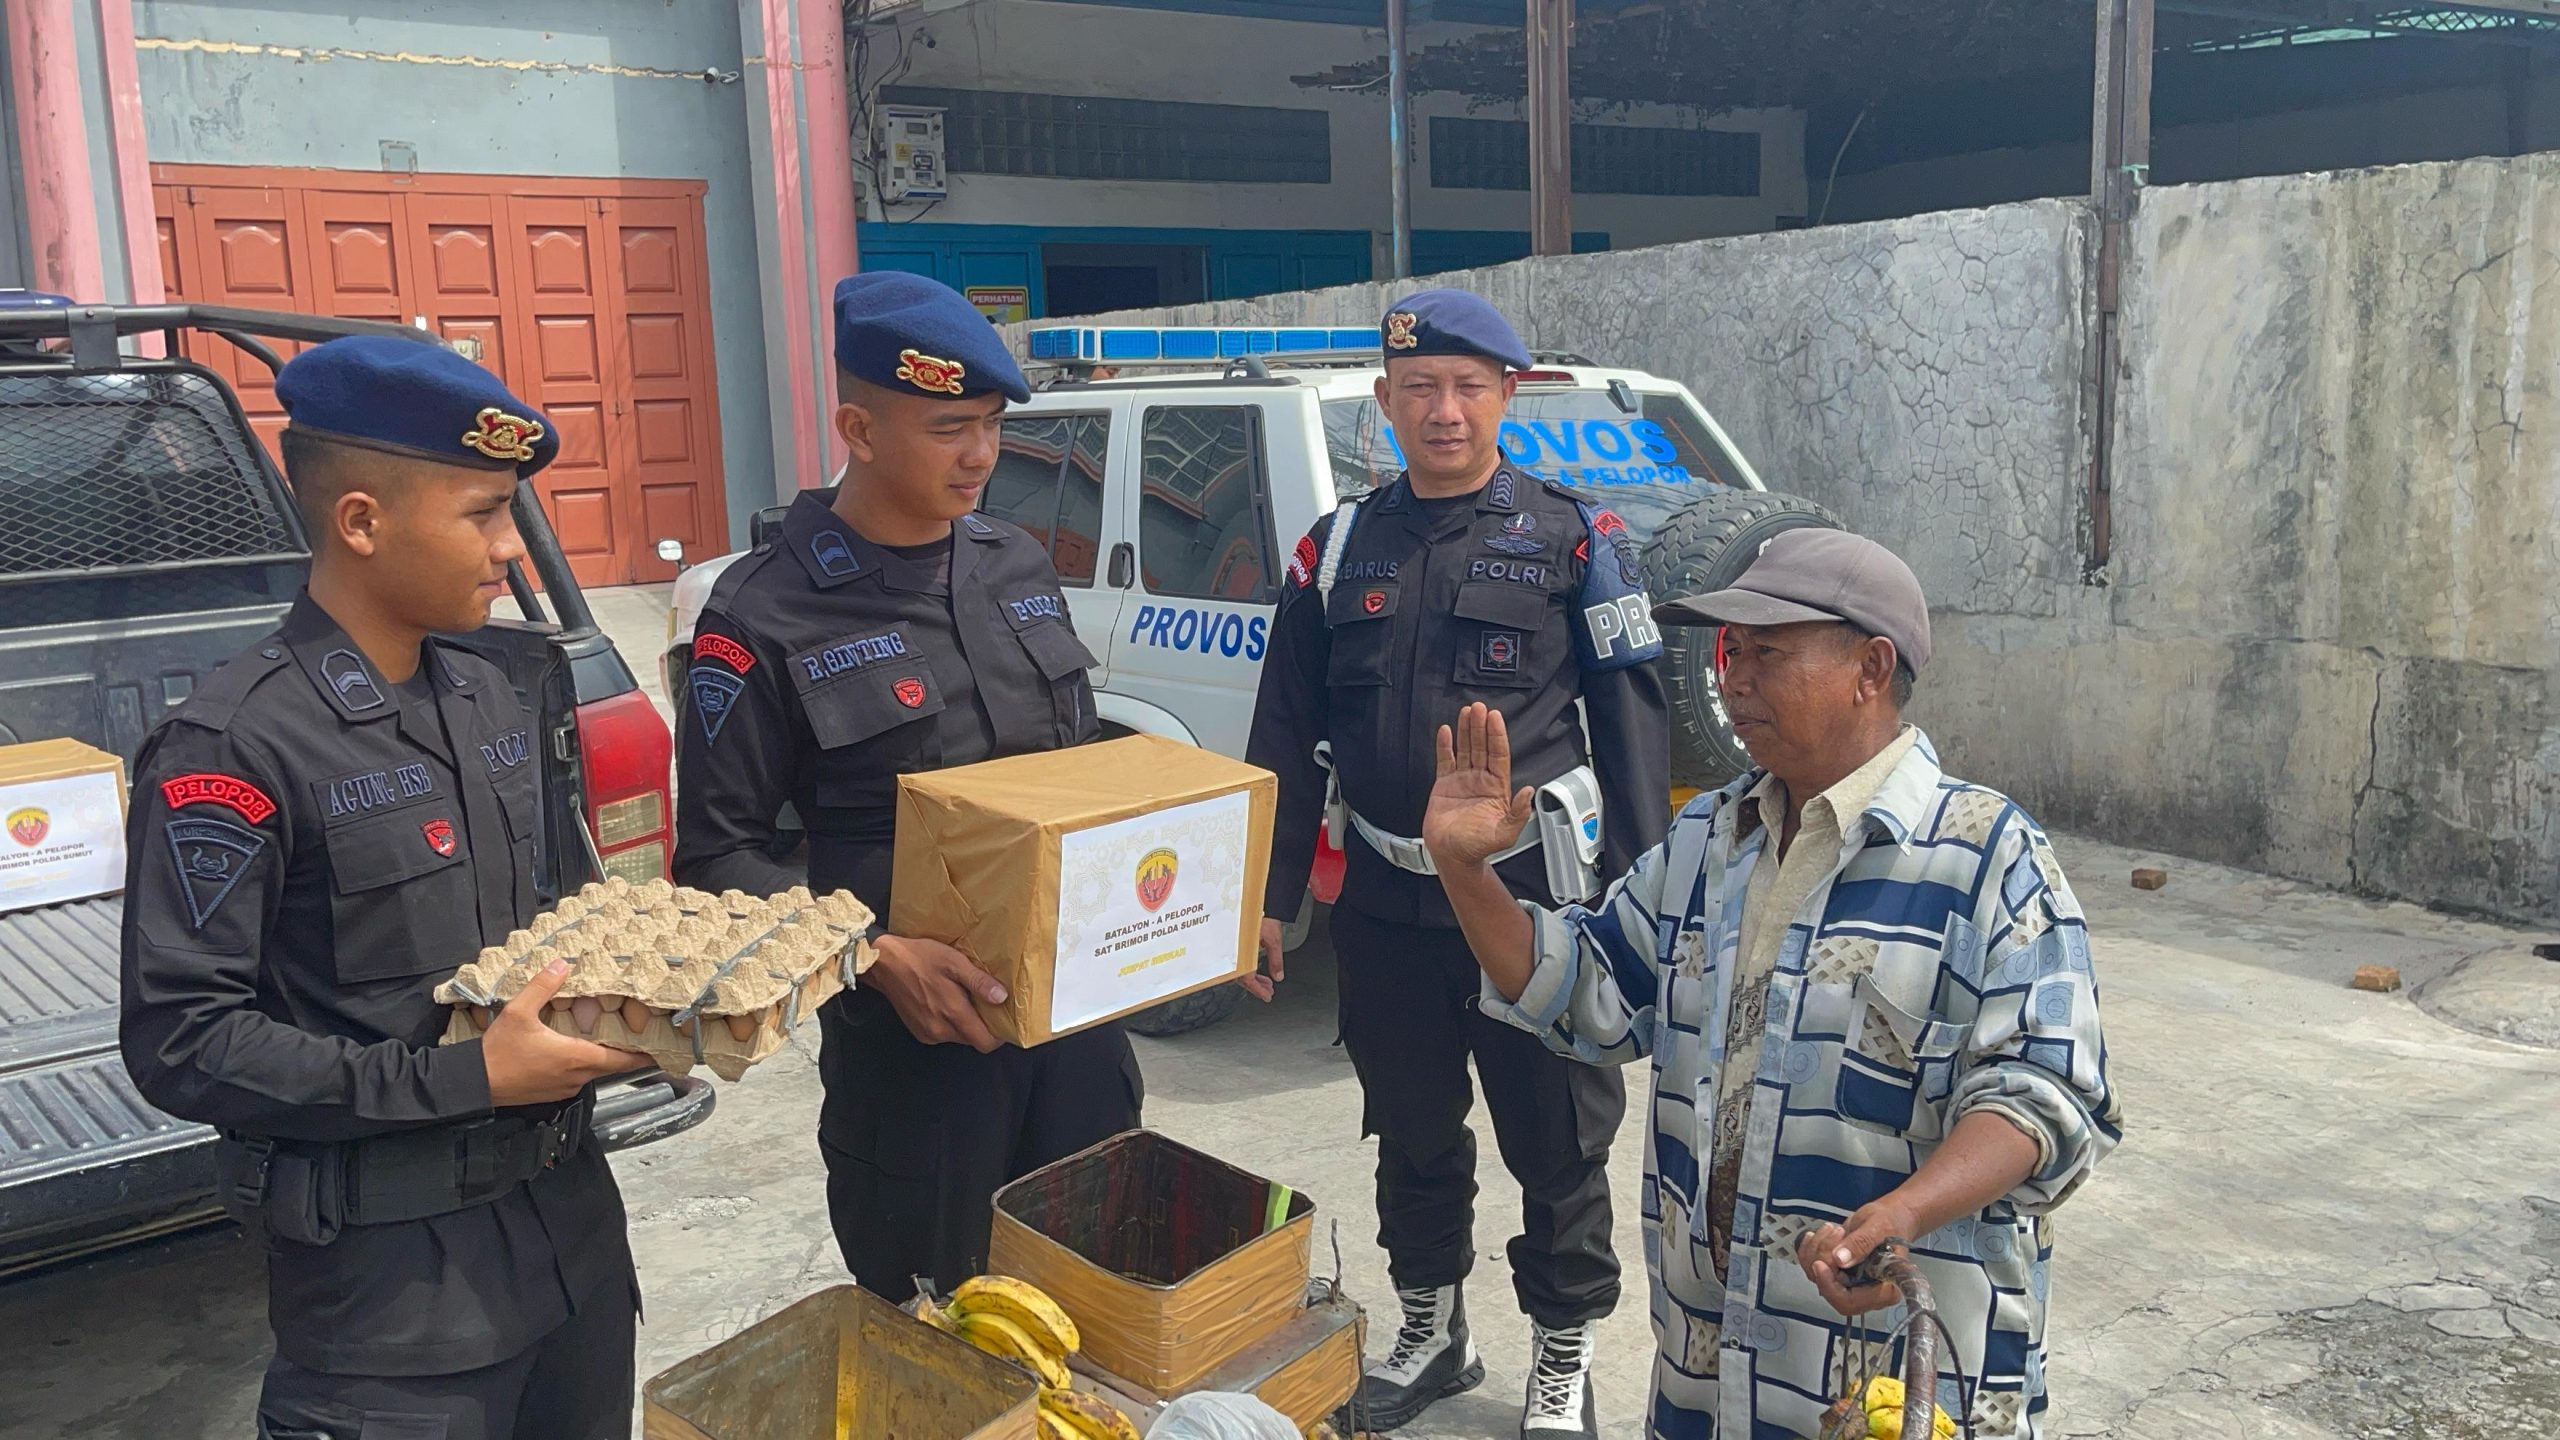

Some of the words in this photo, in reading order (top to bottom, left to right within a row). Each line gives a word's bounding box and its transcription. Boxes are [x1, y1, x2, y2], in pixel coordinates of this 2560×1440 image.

[972, 295, 1023, 304] PERHATIAN
[1383, 418, 1679, 470] OVOS
[1582, 466, 1691, 487] PELOPOR
[1470, 560, 1546, 585] POLRI
[1130, 605, 1267, 661] PROVOS
[1584, 592, 1662, 659] PR
[174, 780, 266, 815] PELOPOR
[330, 772, 395, 817] AGUNG
[395, 763, 433, 798] HSB
[0, 851, 29, 861] ALYON
[45, 843, 84, 854] PELOPOR
[33, 856, 61, 864] POLDA
[63, 850, 93, 859] SUMUT
[1094, 945, 1112, 957] SAT
[1115, 933, 1148, 951] BRIMOB
[1151, 924, 1178, 939] POLDA
[1181, 914, 1210, 930] SUMUT
[1105, 919, 1149, 940] BATALYON
[1157, 915, 1163, 924] A
[1165, 904, 1204, 921] PELOPOR
